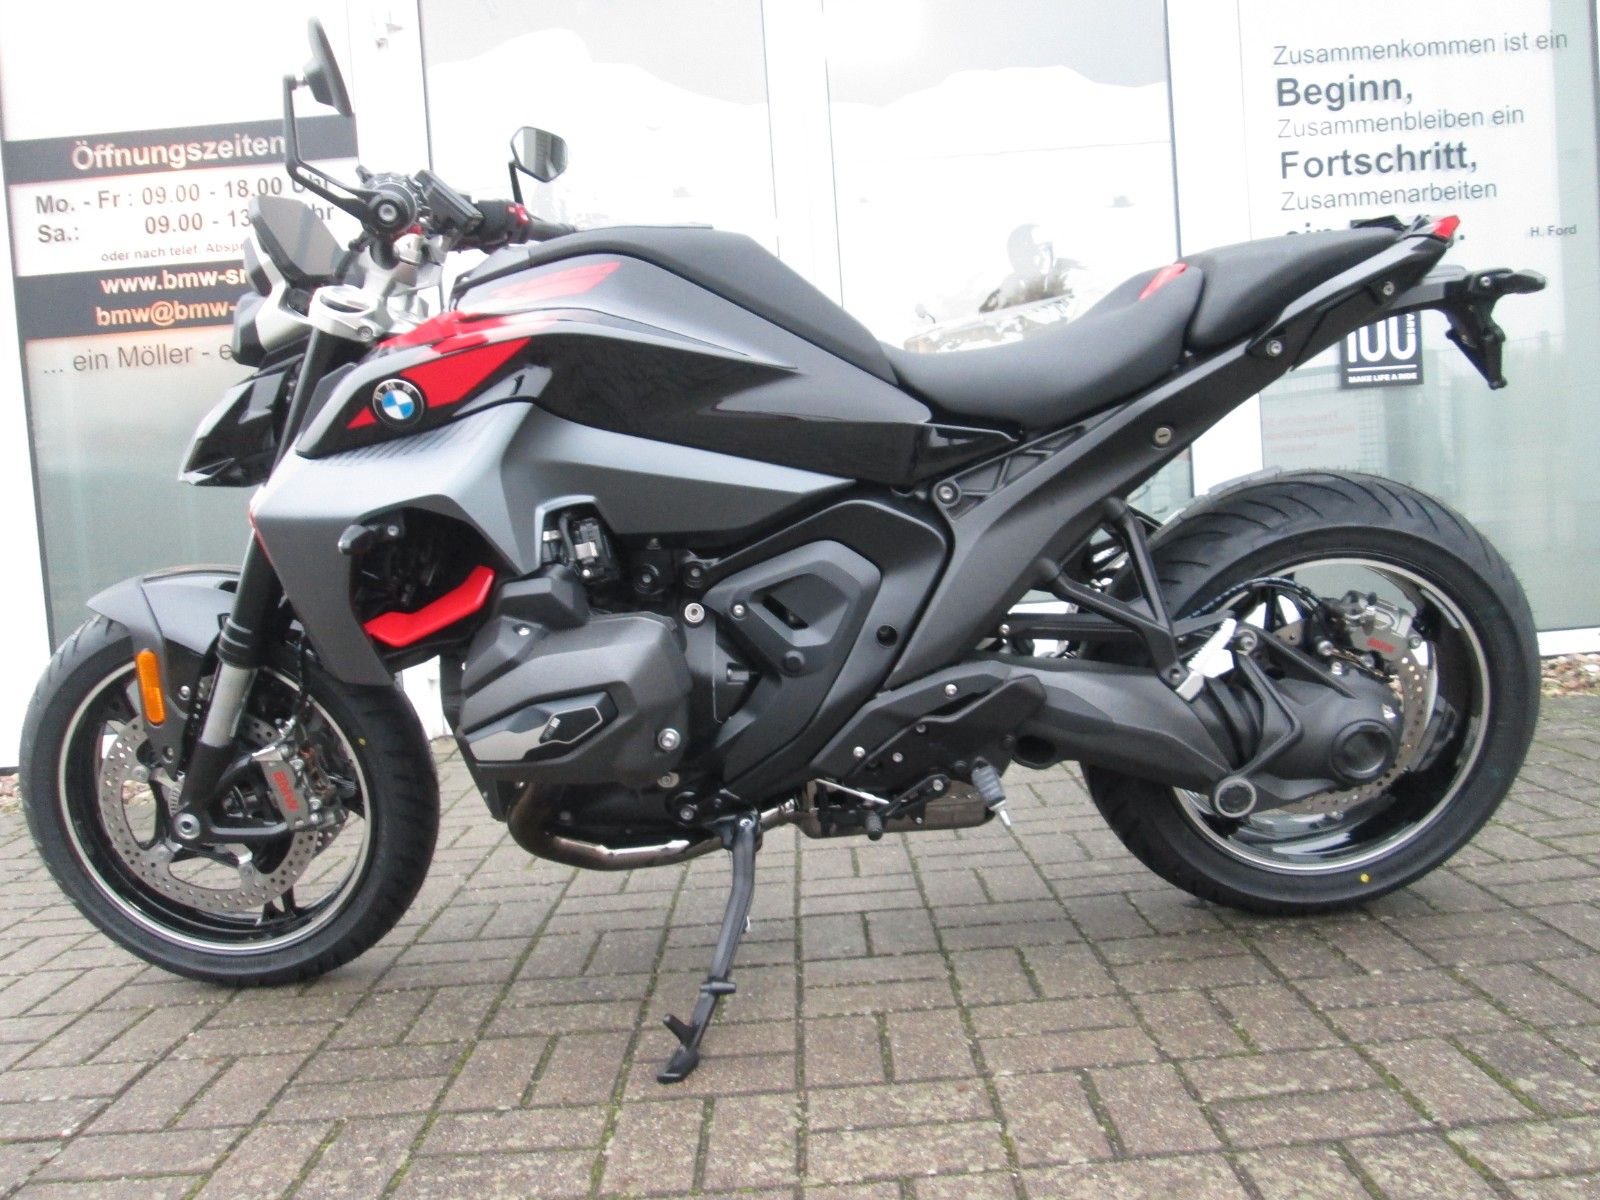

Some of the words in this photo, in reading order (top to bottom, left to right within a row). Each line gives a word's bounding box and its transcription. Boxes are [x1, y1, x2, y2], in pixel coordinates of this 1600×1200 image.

[1273, 38, 1495, 65] Zusammenkommen
[1504, 32, 1528, 51] ist
[1536, 30, 1568, 50] ein
[1276, 74, 1413, 111] Beginn,
[1277, 108, 1484, 138] Zusammenbleiben
[1492, 106, 1525, 126] ein
[72, 133, 286, 170] Öffnungszeiten
[1280, 141, 1477, 179] Fortschritt,
[35, 195, 75, 214] Mo.
[142, 183, 200, 206] 09.00
[224, 176, 282, 198] 18.00
[1281, 181, 1497, 211] Zusammenarbeiten
[38, 224, 79, 243] Sa.:
[145, 213, 203, 235] 09.00
[228, 208, 251, 228] 13
[311, 203, 334, 220] hr
[1546, 223, 1577, 237] Ford
[101, 250, 129, 262] oder
[134, 247, 166, 259] nach
[207, 241, 243, 254] Abspr
[100, 268, 245, 294] www.bmw-s
[96, 300, 236, 326] bmw@bmw-
[73, 348, 109, 372] ein
[117, 343, 192, 369] Möller
[374, 382, 414, 401] BMW
